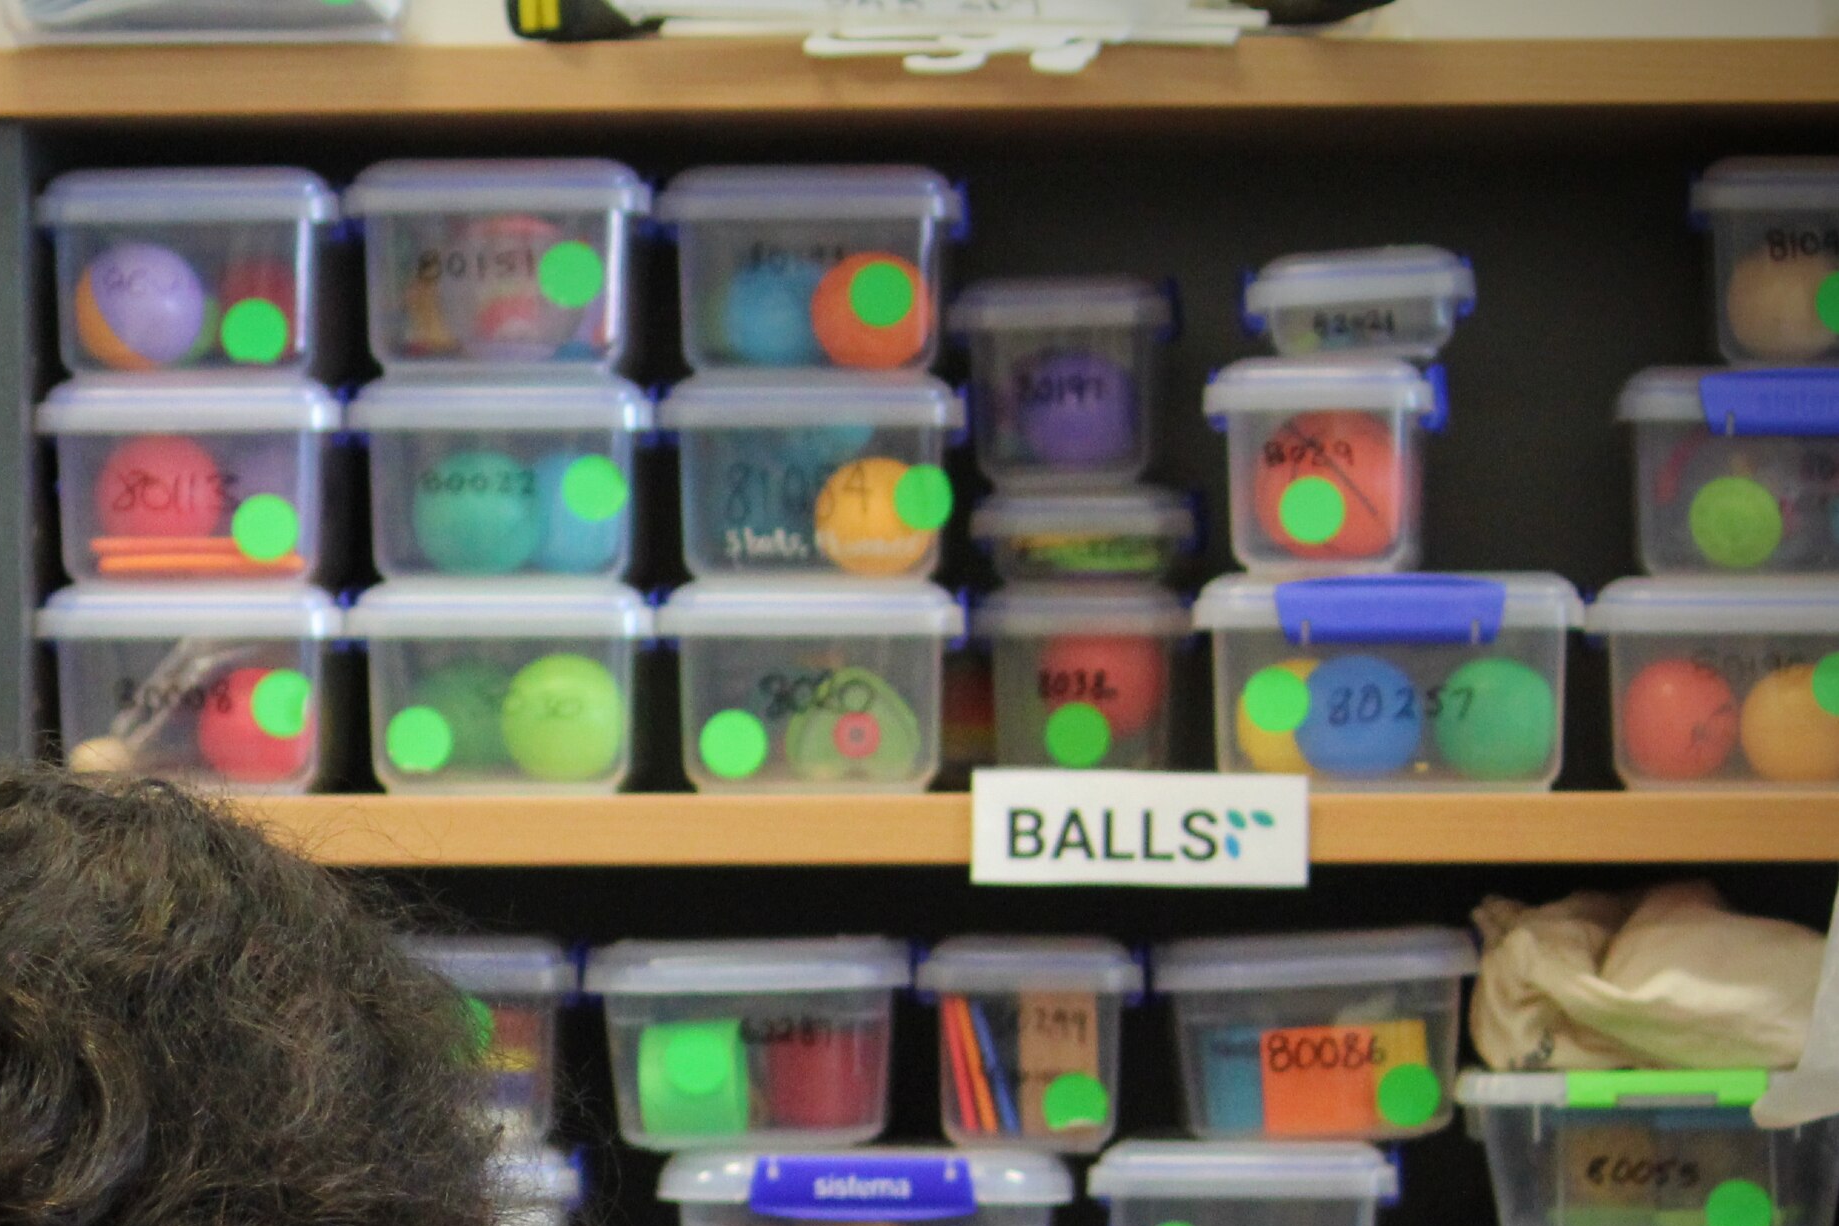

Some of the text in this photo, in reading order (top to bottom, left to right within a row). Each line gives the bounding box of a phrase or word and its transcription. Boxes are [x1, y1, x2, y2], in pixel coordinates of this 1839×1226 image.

[1327, 682, 1477, 728] 80257
[1009, 811, 1217, 861] BALLS
[1266, 1032, 1387, 1072] 80086
[813, 1174, 912, 1200] sistema
